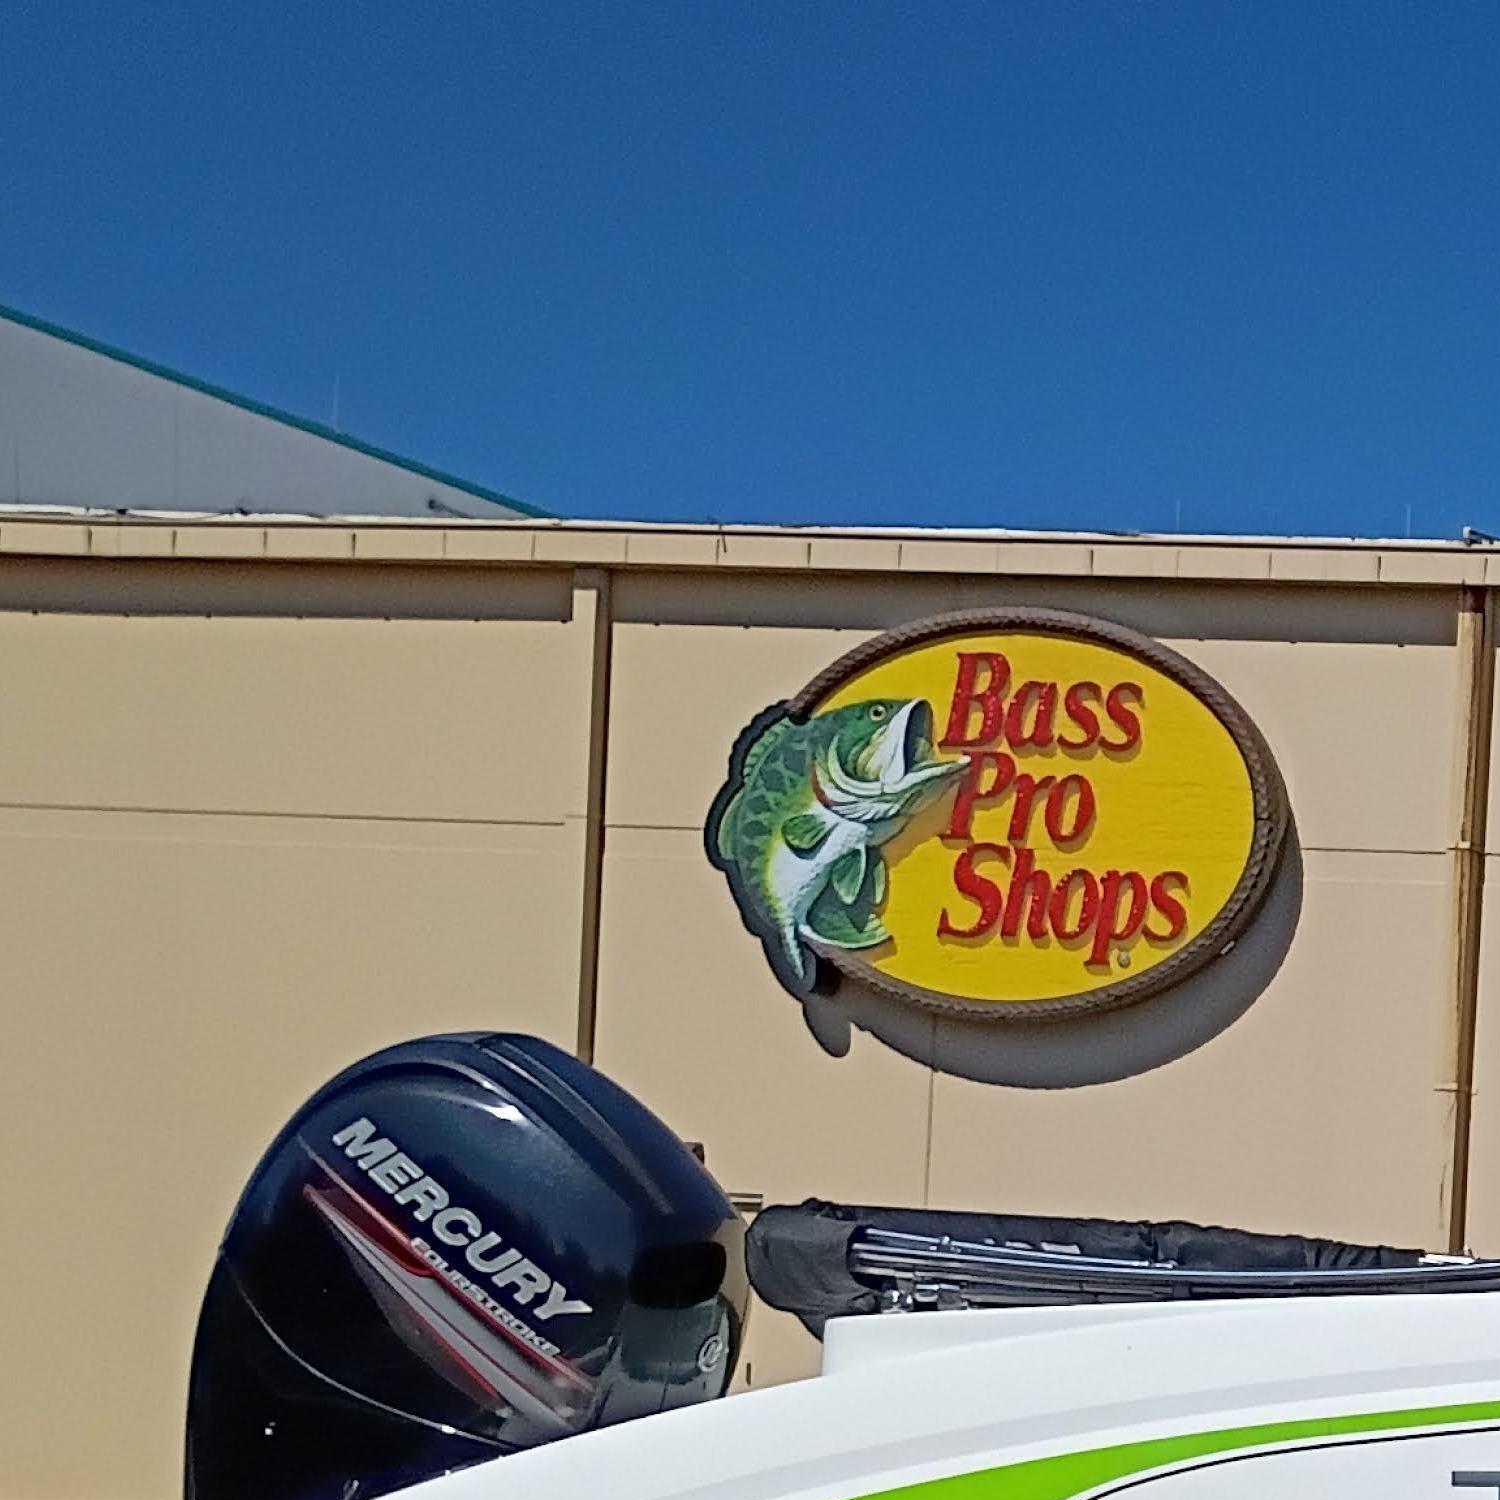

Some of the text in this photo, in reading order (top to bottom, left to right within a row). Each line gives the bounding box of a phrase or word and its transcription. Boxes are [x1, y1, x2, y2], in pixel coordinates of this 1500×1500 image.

[938, 652, 1145, 754] Bass
[938, 752, 1096, 845] Pro
[937, 843, 1189, 968] Shops
[333, 1117, 593, 1320] MERCURY
